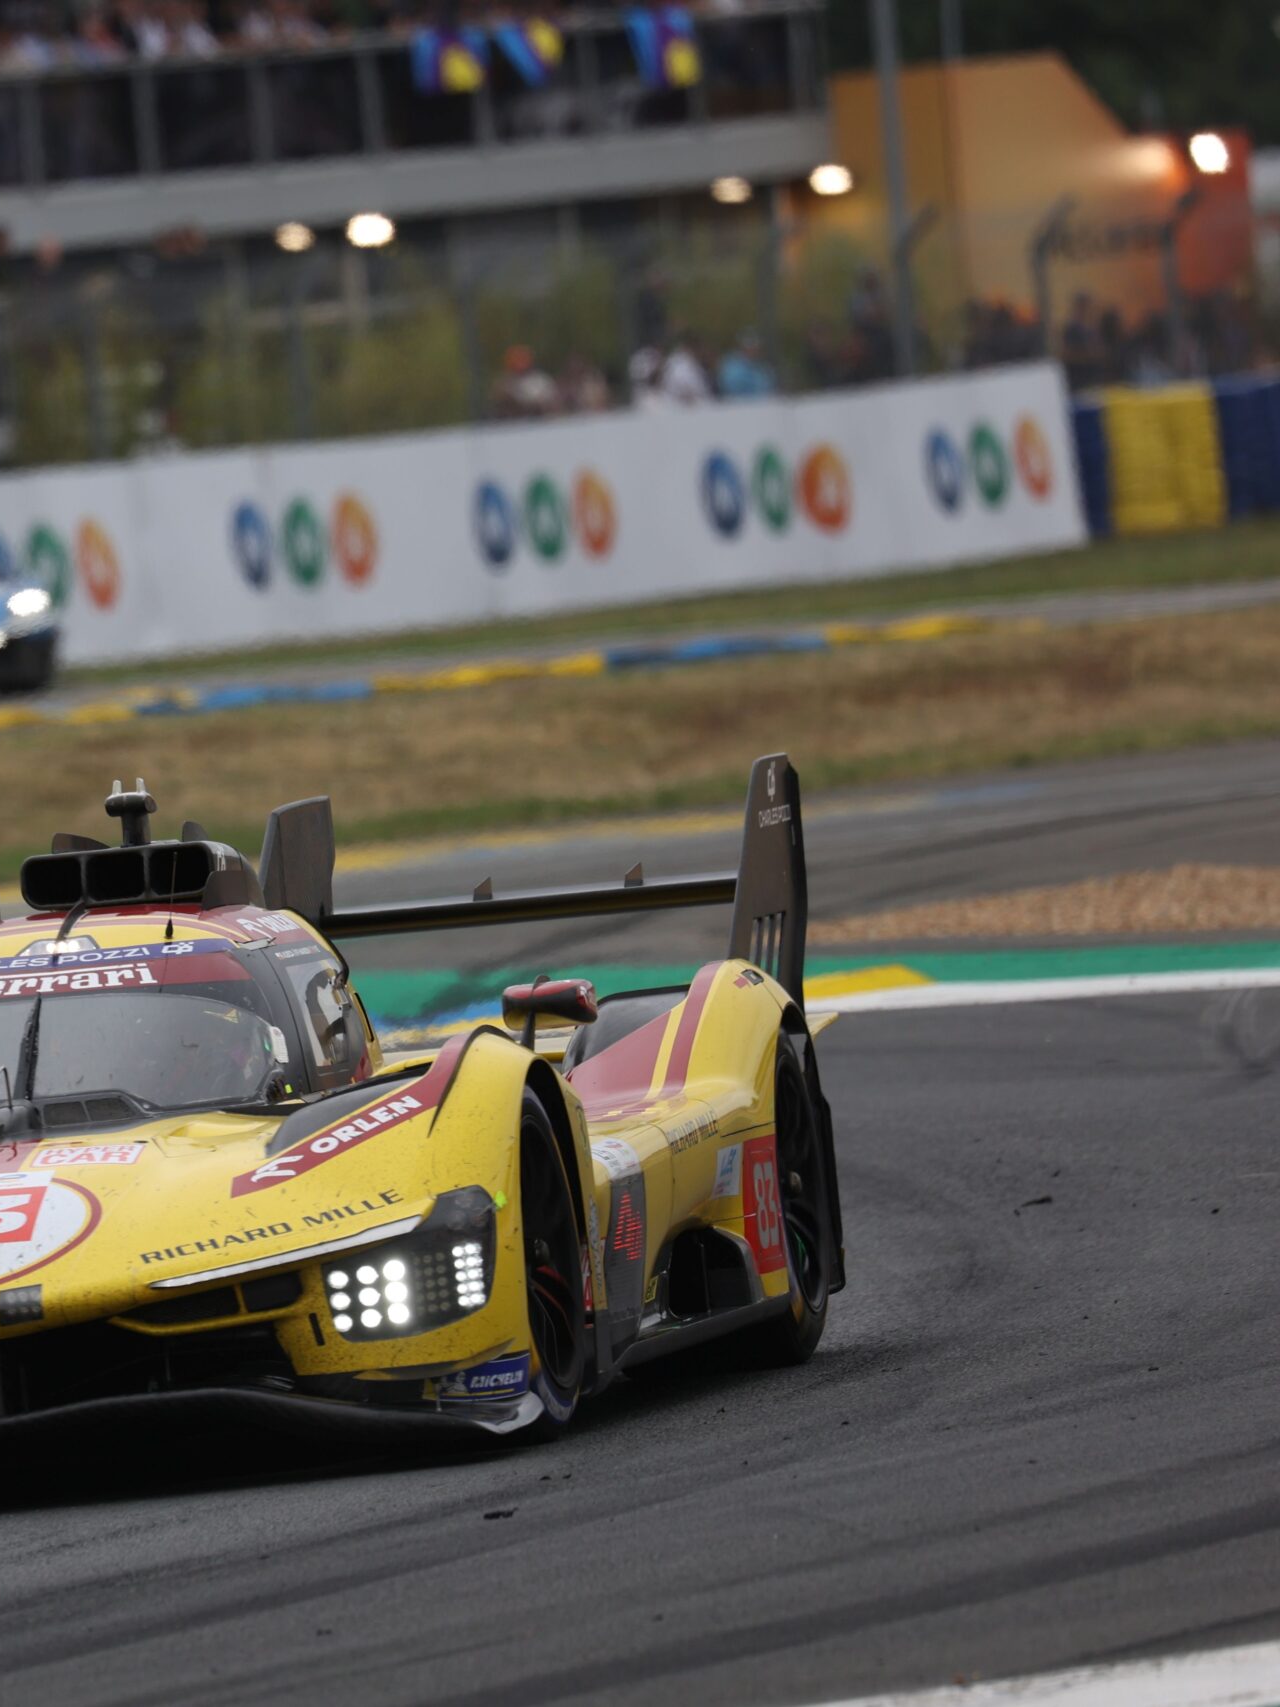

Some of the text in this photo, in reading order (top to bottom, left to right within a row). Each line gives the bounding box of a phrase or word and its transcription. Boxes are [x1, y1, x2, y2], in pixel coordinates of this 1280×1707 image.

[58, 946, 151, 965] POZZI
[310, 1095, 423, 1154] ORLEN
[41, 1151, 131, 1165] CAR
[139, 1188, 404, 1265] RICHARD MILLE
[753, 1161, 780, 1249] 83
